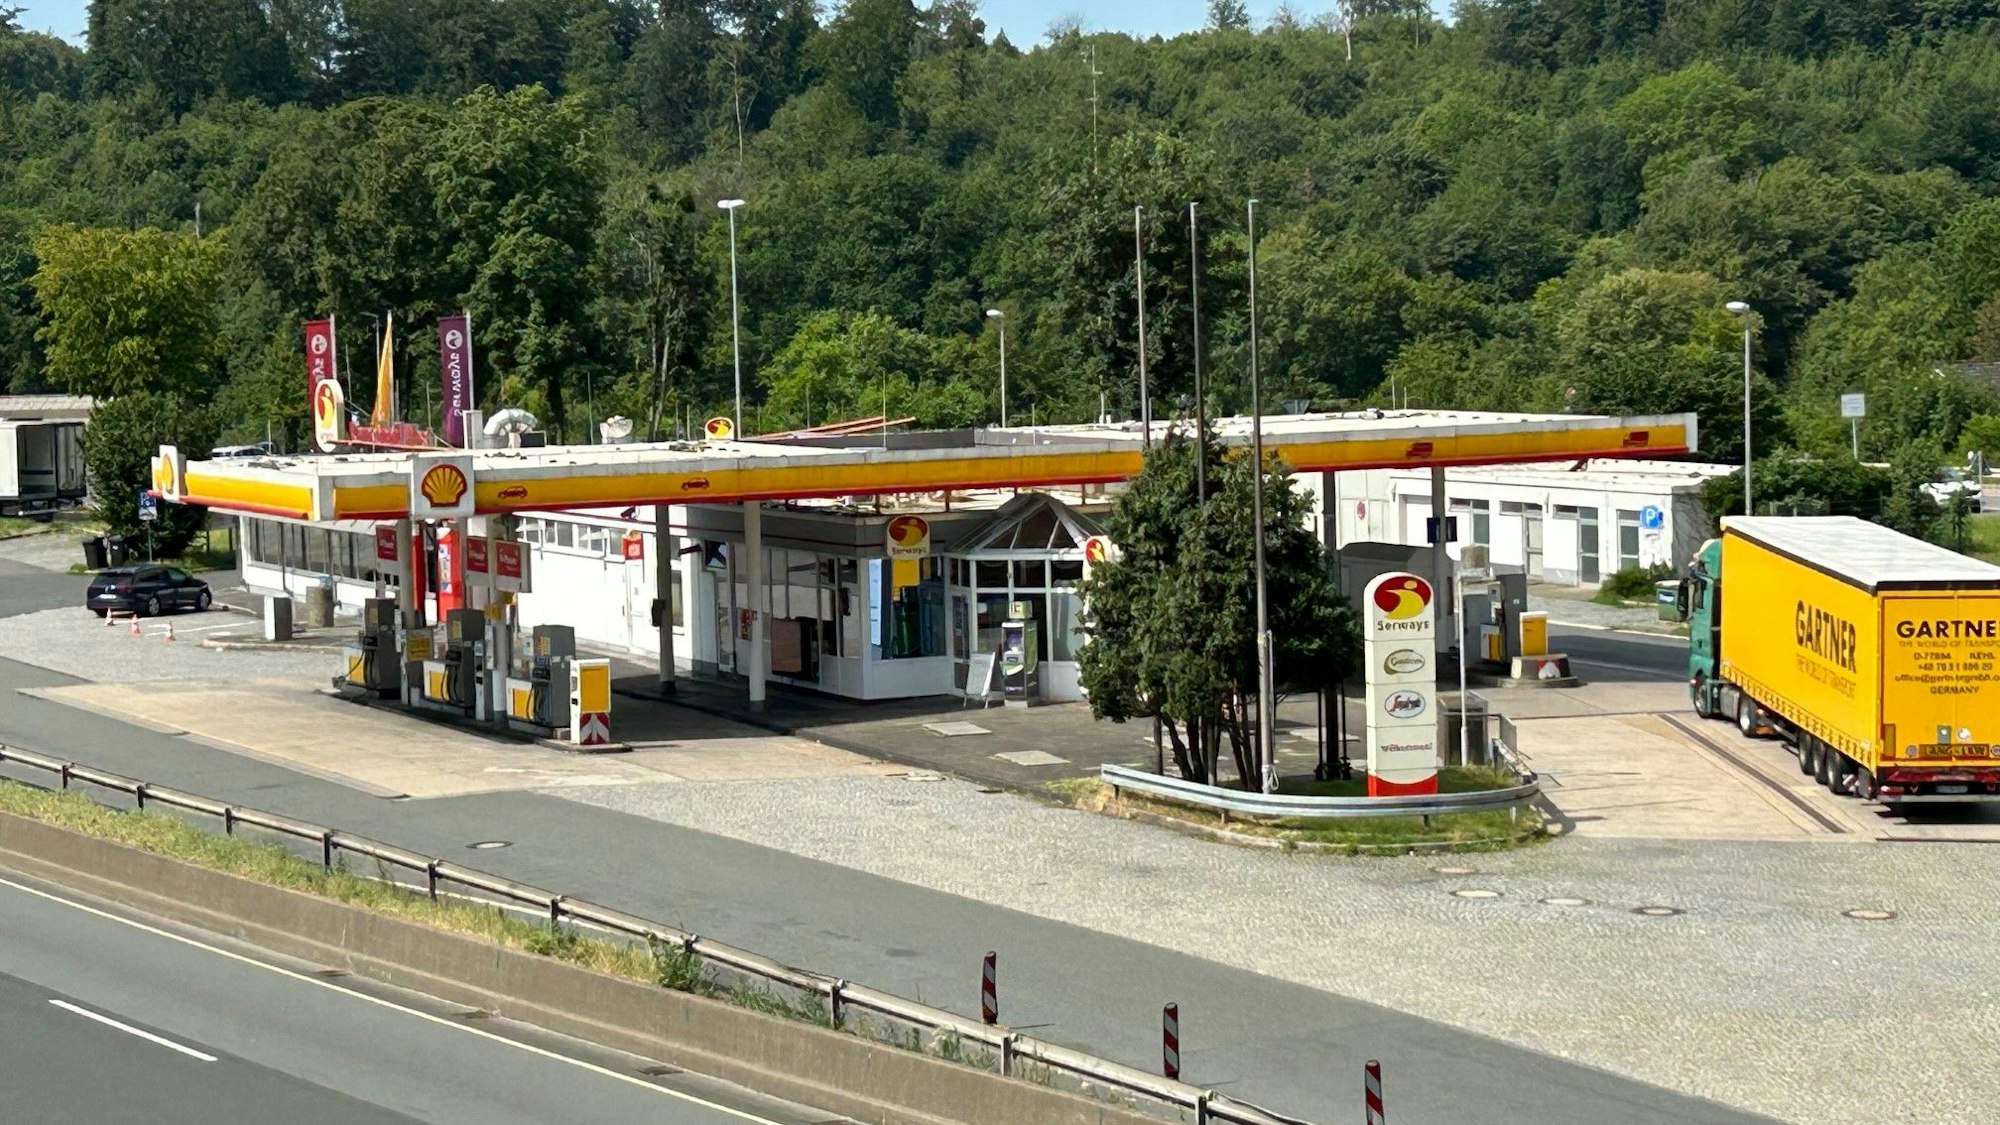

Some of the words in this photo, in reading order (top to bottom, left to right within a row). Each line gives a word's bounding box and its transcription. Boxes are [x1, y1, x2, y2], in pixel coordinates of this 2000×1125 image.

[1377, 620, 1430, 631] Serways
[1896, 620, 2000, 639] GARTNE
[1796, 599, 1857, 674] GARTNER
[1930, 685, 1980, 695] GERMANY
